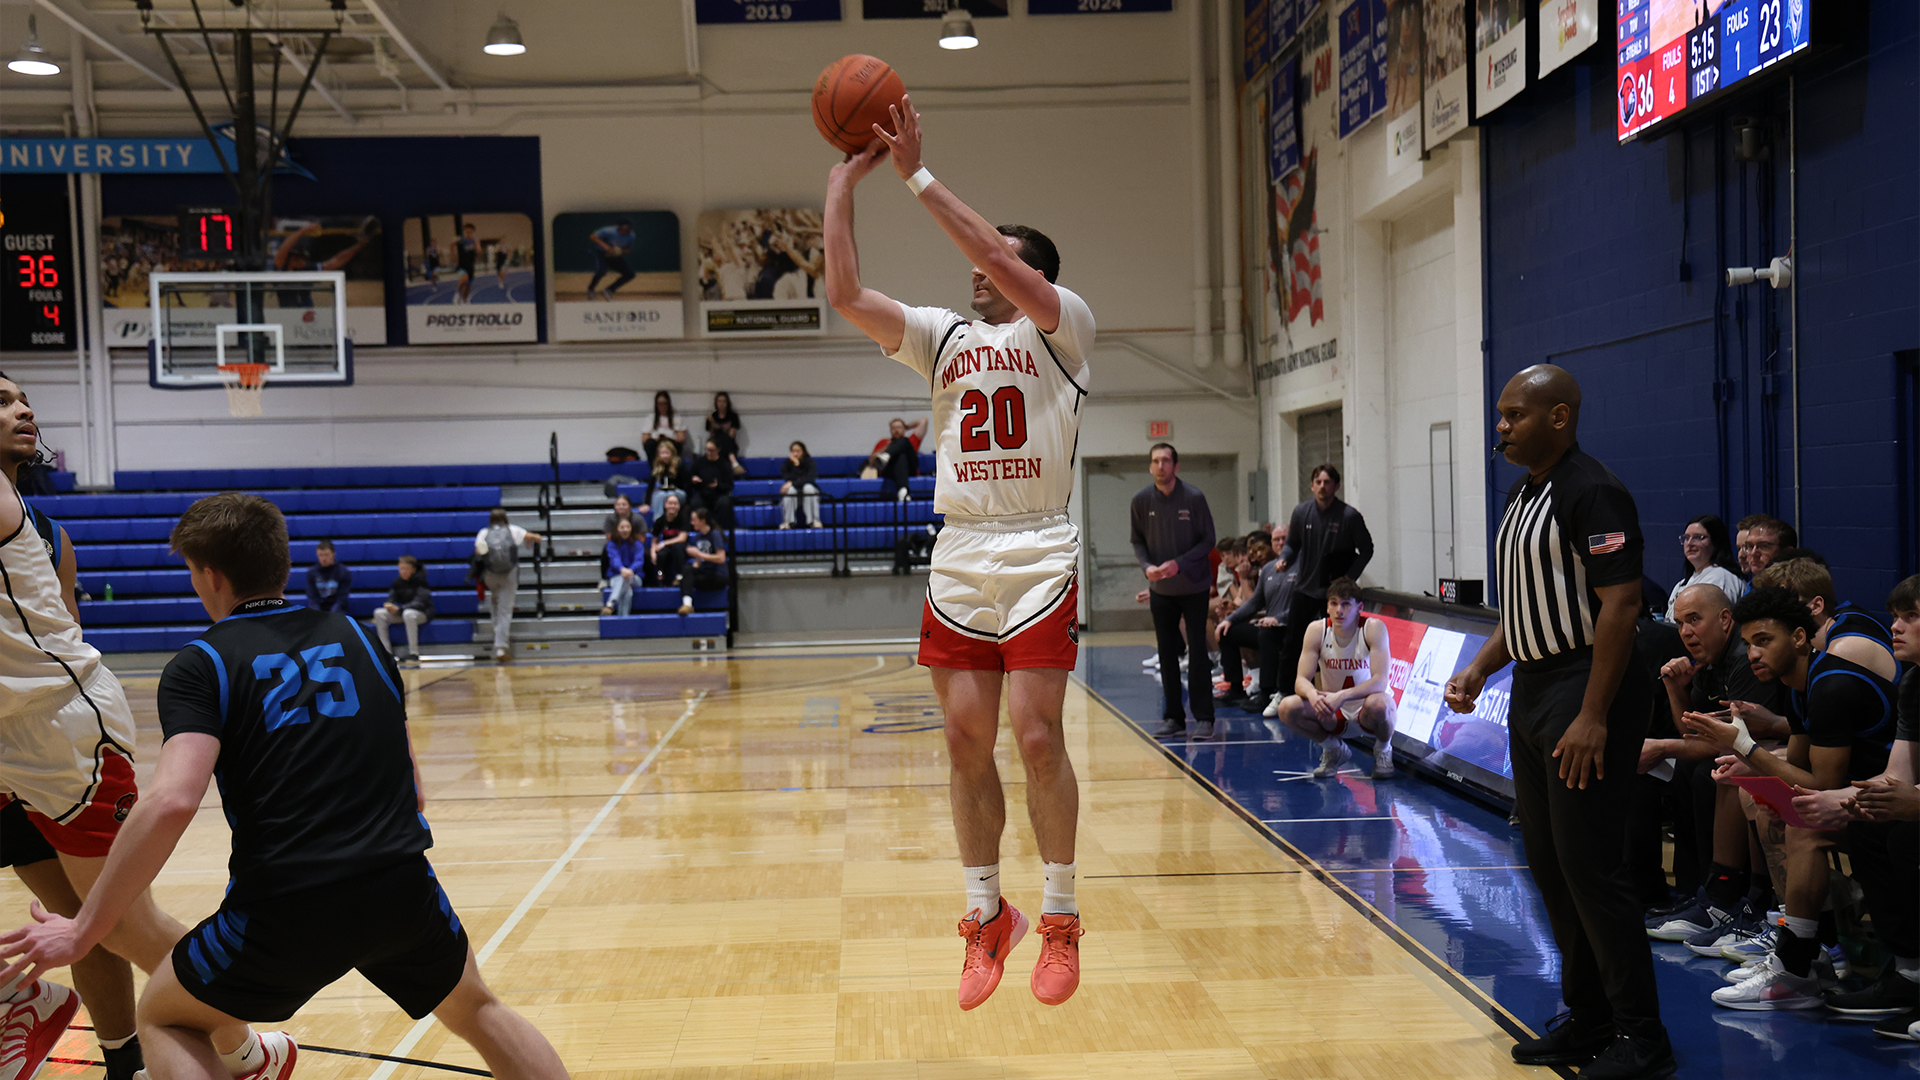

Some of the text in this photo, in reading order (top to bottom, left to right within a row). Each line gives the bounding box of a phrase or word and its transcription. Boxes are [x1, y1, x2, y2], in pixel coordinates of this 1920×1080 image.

[744, 4, 793, 21] 2019
[1726, 7, 1749, 36] FOULS
[1759, 0, 1781, 54] 23
[1625, 39, 1642, 62] STEALS
[1662, 45, 1682, 71] FOULS
[1691, 26, 1715, 68] 5:15
[1735, 40, 1741, 71] 1
[1637, 69, 1654, 117] 36
[1668, 76, 1676, 105] 4
[1695, 67, 1711, 97] 1ST
[0, 144, 193, 168] NIVERSITY
[4, 234, 55, 251] GUEST
[200, 214, 233, 251] 17
[18, 254, 59, 287] 36
[28, 289, 63, 302] FOULS
[43, 304, 60, 327] 4
[426, 312, 523, 327] PROSTROLLO
[583, 310, 661, 325] SANFORD
[735, 315, 778, 326] NATIONAL
[780, 314, 810, 324] GUARD
[31, 331, 66, 345] SCORE
[941, 345, 1040, 390] MONTANA
[960, 385, 1028, 453] 20
[1150, 420, 1169, 437] EXIT
[954, 457, 1042, 483] WESTERN
[1442, 581, 1457, 599] POSS
[245, 598, 284, 610] NIKE PRO
[1323, 658, 1370, 670] MONTANA
[251, 642, 361, 733] 25
